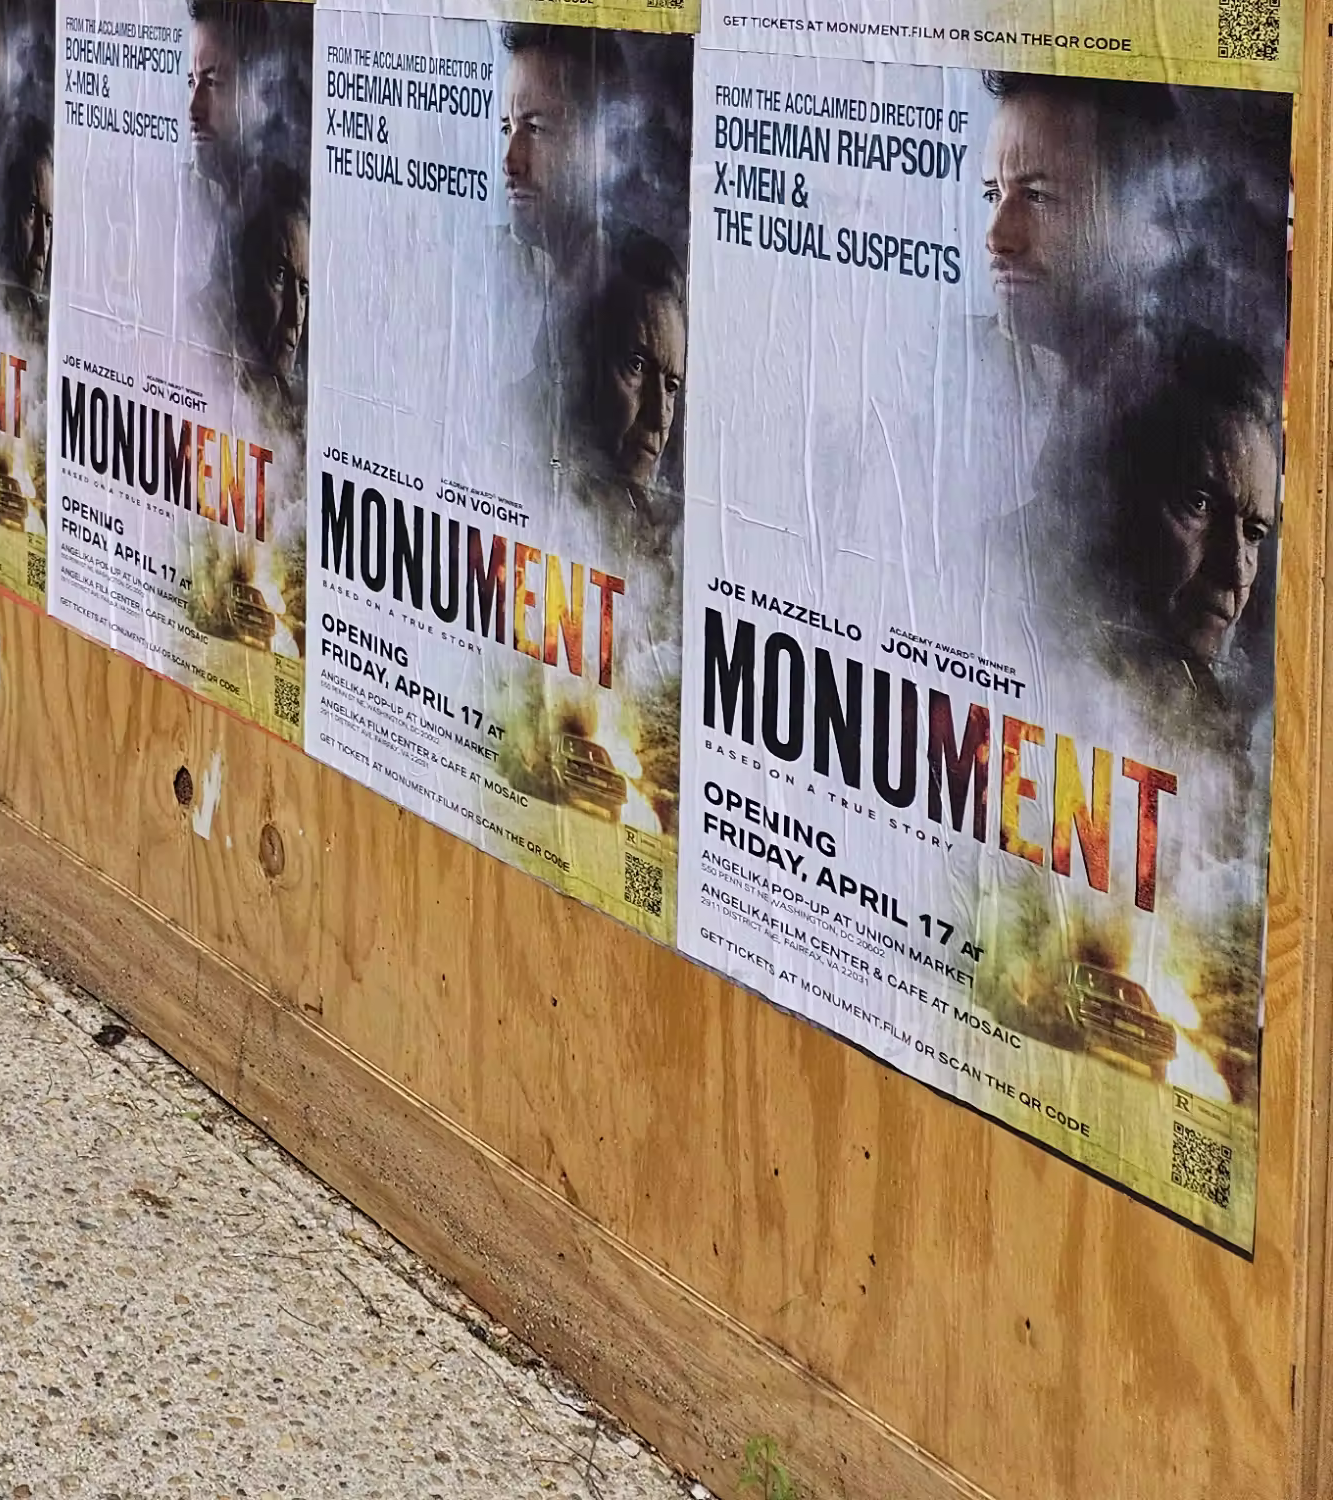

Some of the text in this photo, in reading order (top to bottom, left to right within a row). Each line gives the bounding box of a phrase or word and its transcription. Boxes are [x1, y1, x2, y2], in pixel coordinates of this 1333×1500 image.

[723, 15, 1132, 51] GET TICKETS AT MONUMENT.FILM OR SCAN THE QR CODE
[714, 161, 809, 209] X-MEN &
[715, 115, 968, 182] BOHEMIAN RHAPSODY
[713, 207, 961, 284] THE USUAL SUSPECTS
[61, 376, 273, 542] MONUMENT
[62, 496, 124, 535] OPENING
[321, 471, 625, 689] MONUMENT
[321, 613, 409, 668] OPENING
[703, 607, 1177, 913] MONUMENT
[703, 781, 837, 858] OPENING
[703, 811, 985, 964] FRIDAY, APRIL 17 AT
